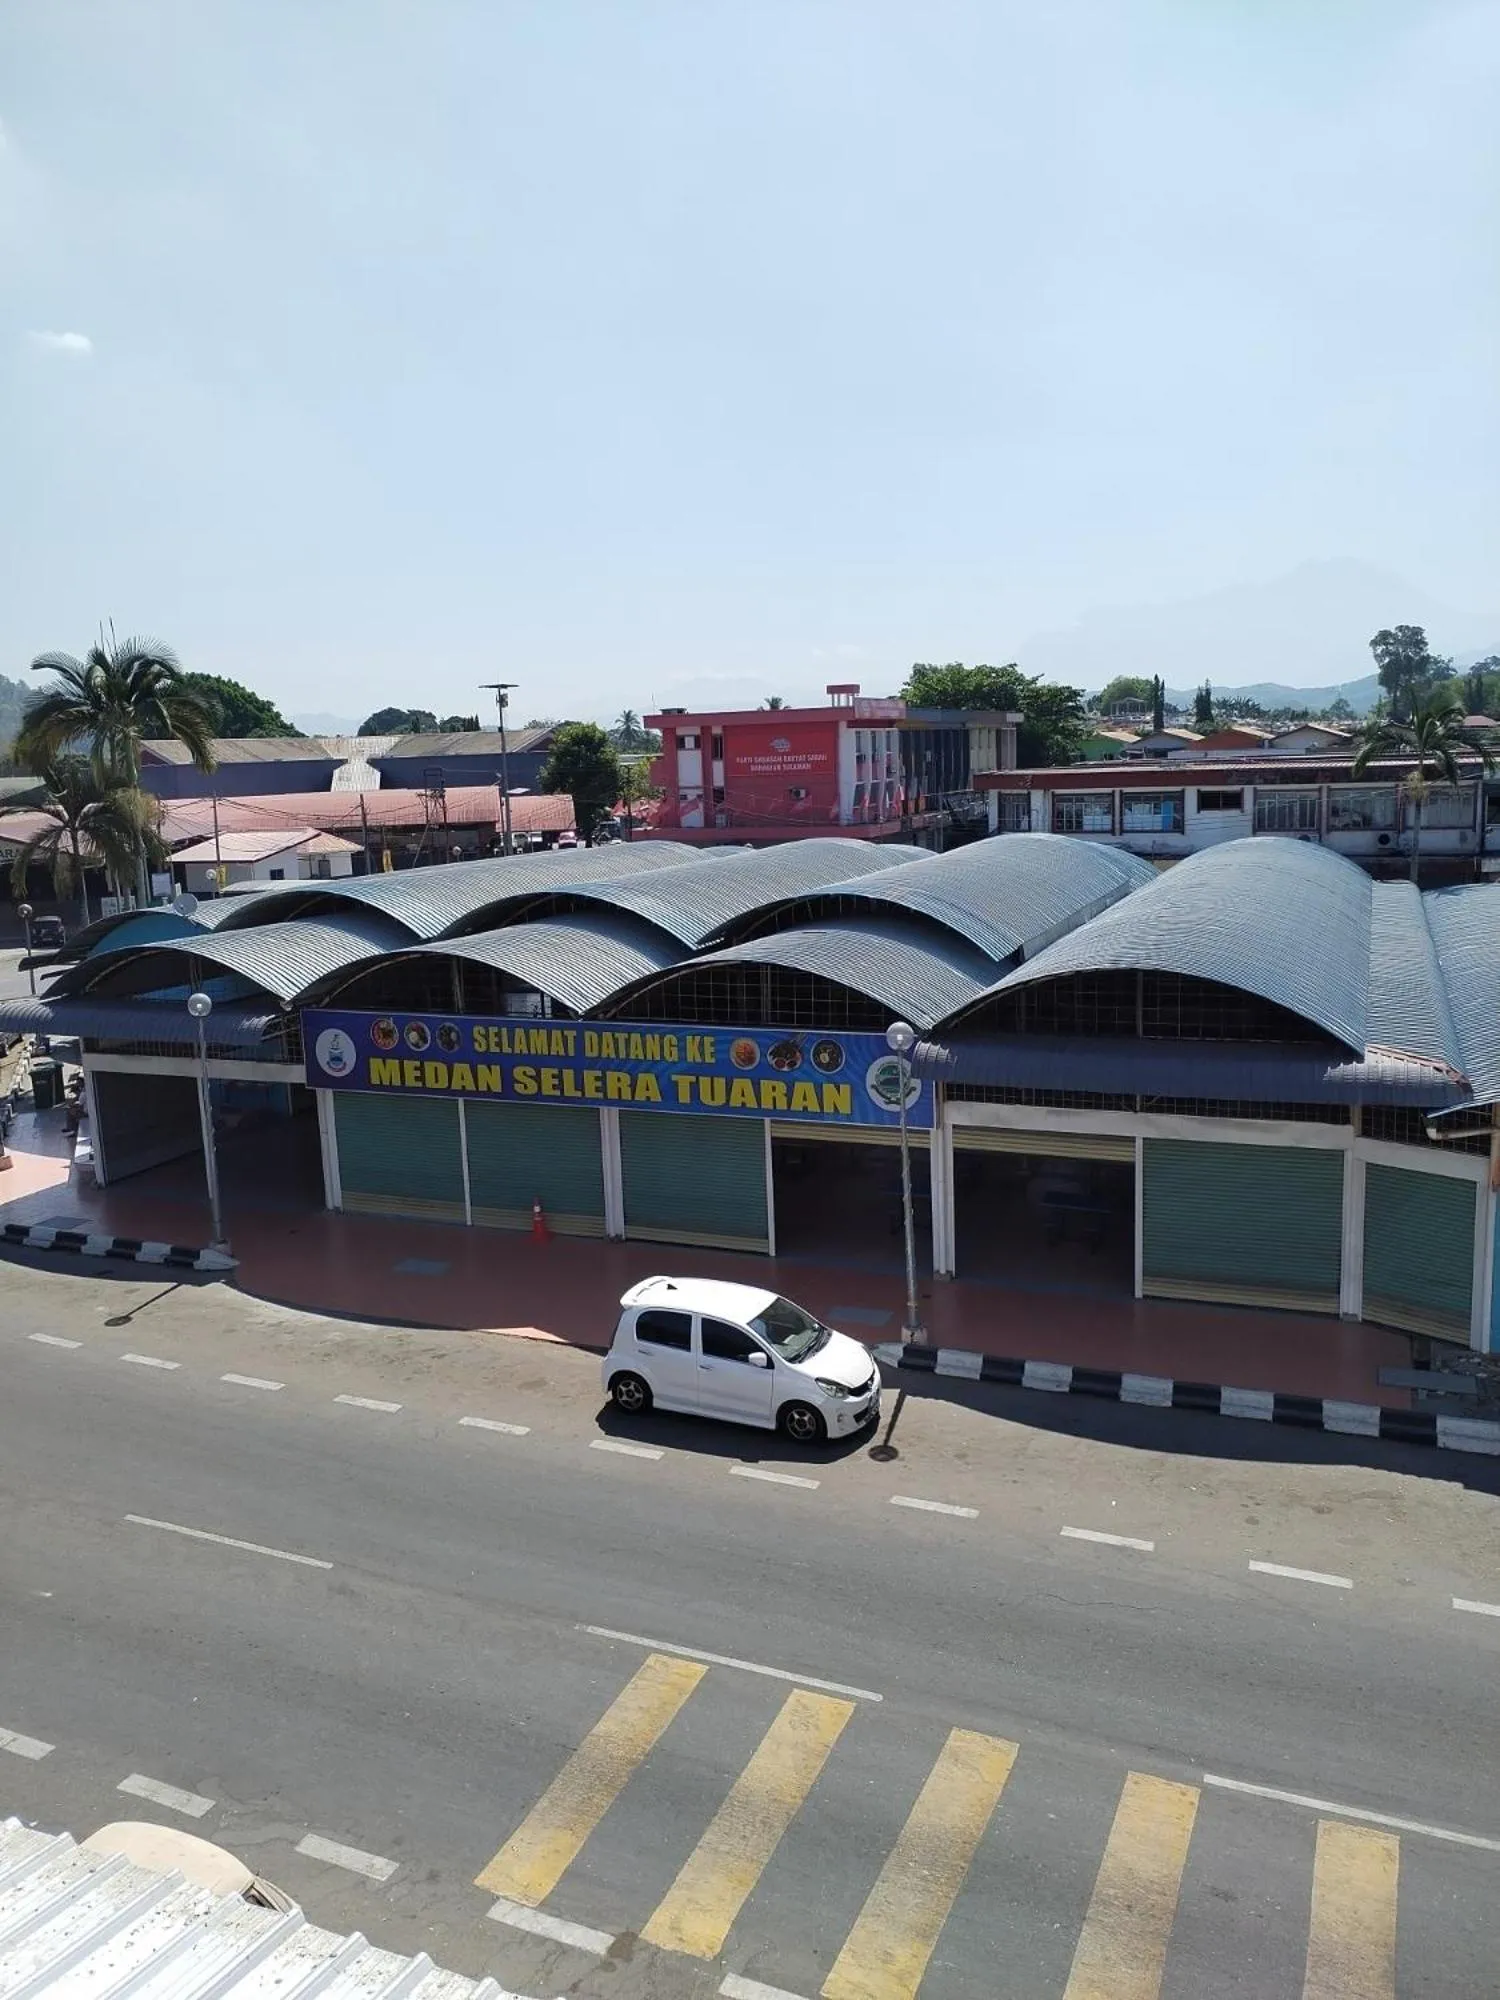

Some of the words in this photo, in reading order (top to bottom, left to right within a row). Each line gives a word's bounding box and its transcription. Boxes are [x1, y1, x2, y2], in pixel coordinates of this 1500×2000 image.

[472, 1025, 577, 1057] SELAMAT
[584, 1030, 679, 1063] DATANG
[686, 1034, 716, 1064] KE
[368, 1057, 502, 1093] MEDAN
[512, 1065, 662, 1102] SELERA
[671, 1074, 852, 1115] TUARAN
